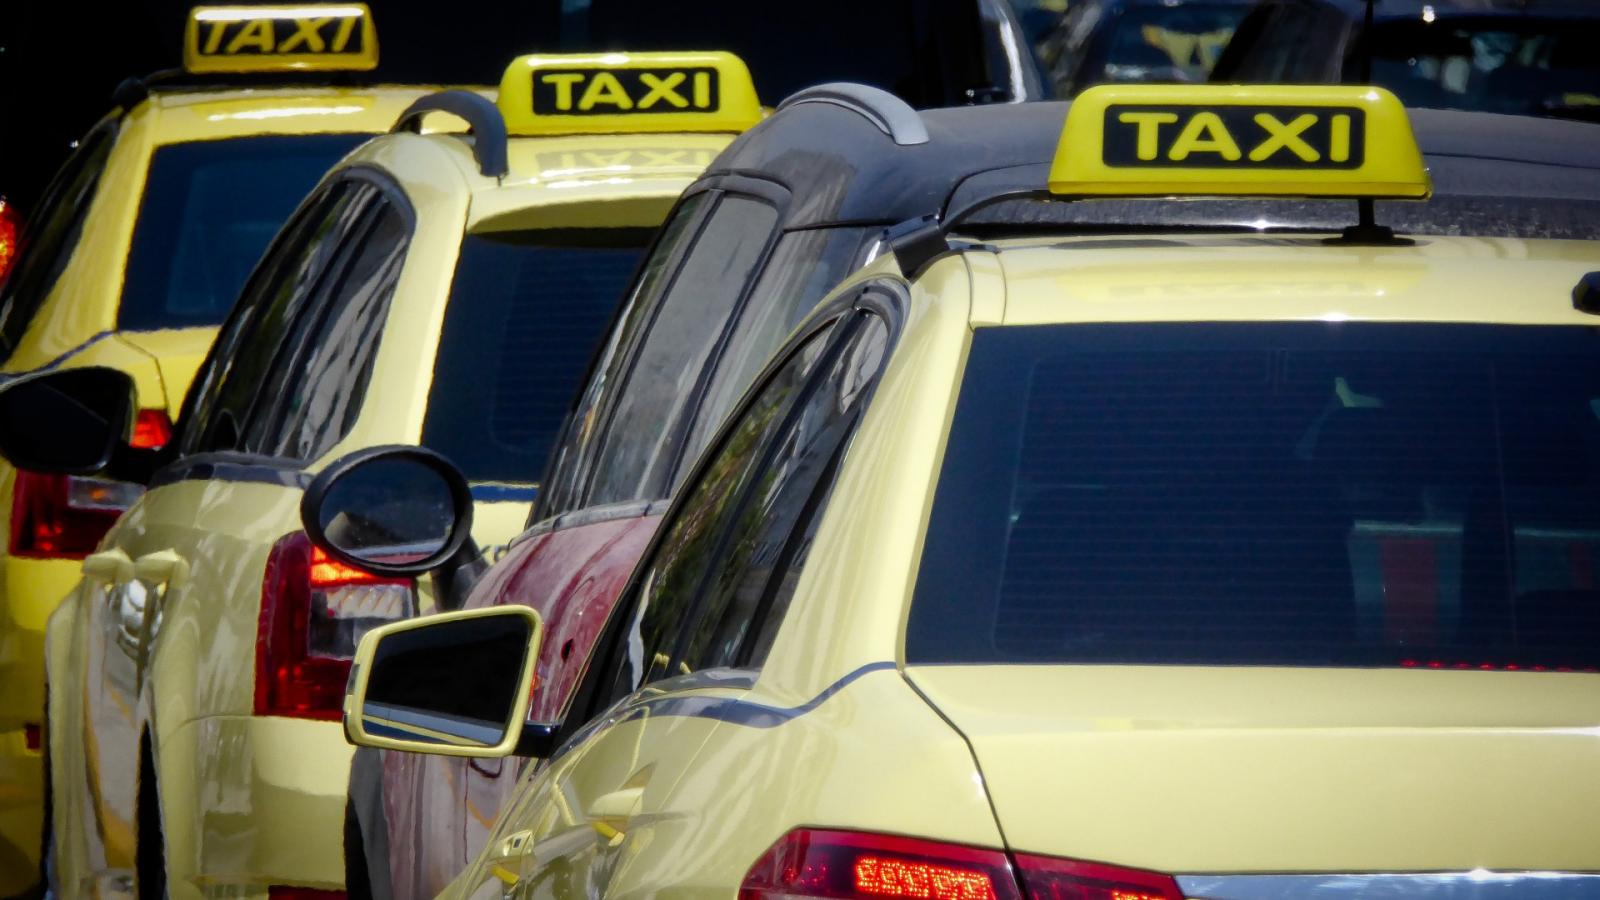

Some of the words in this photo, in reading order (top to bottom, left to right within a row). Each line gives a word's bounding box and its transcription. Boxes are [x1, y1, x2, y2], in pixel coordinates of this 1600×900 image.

[203, 17, 357, 54] TAXI
[541, 72, 711, 111] TAXI
[1118, 112, 1351, 162] TAXI
